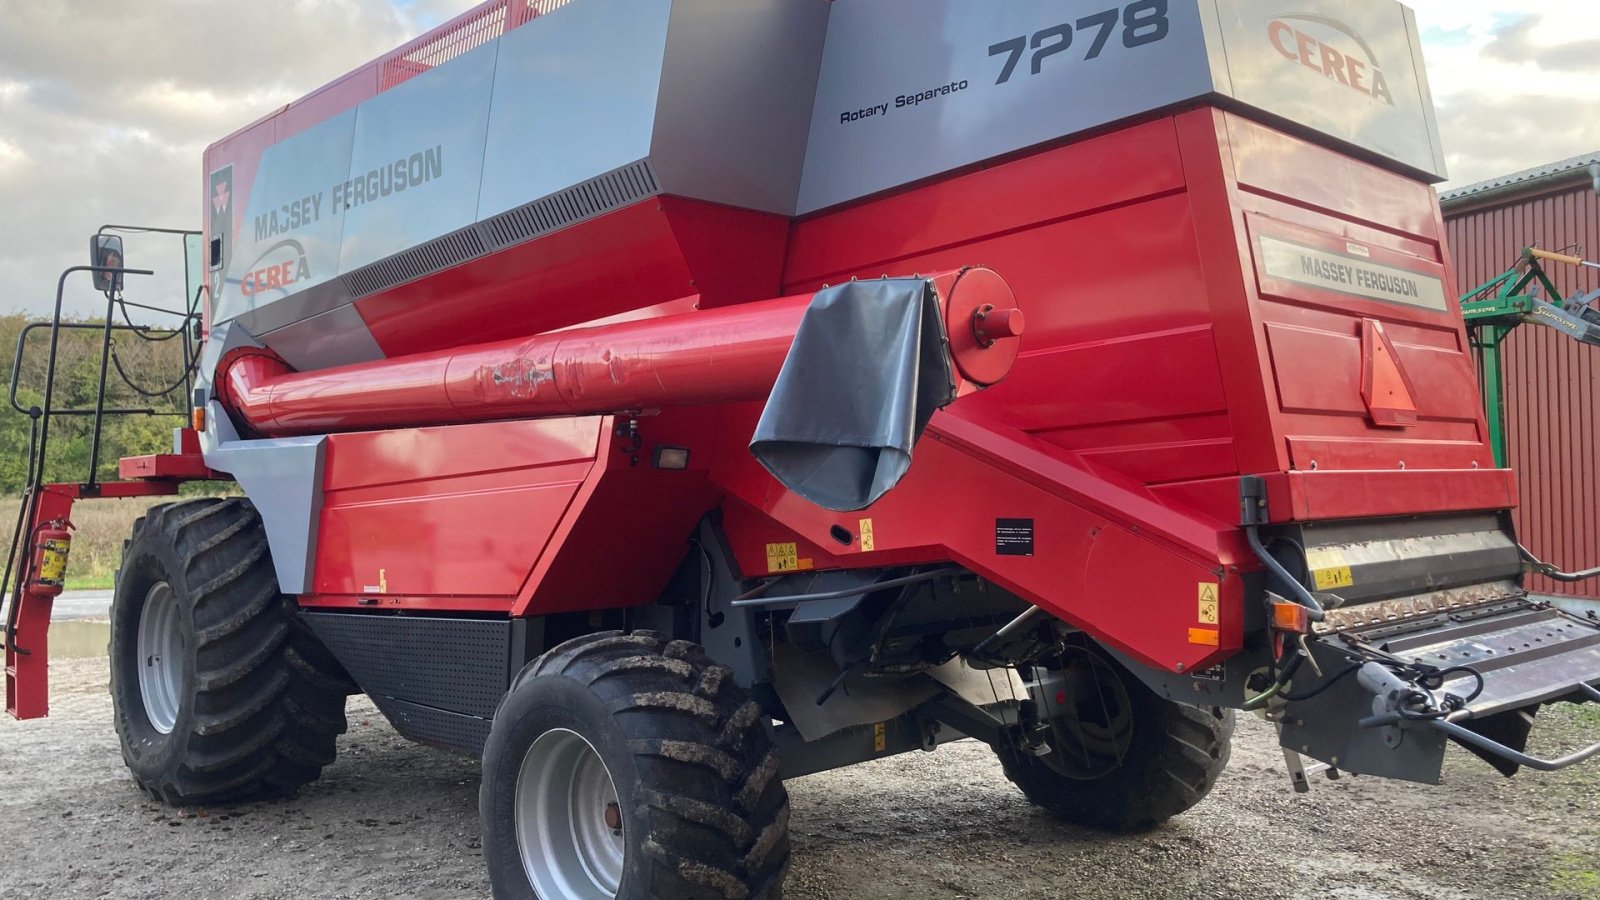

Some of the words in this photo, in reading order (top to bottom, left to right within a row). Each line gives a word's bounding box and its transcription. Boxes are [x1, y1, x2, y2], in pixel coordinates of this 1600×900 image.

[1267, 20, 1395, 106] CEREA
[840, 101, 889, 124] Rotary
[895, 79, 968, 108] Separato
[240, 255, 311, 298] CEREA
[1300, 255, 1353, 284] MASSEY
[1356, 269, 1418, 297] FERGUSON
[1461, 306, 1496, 315] amson
